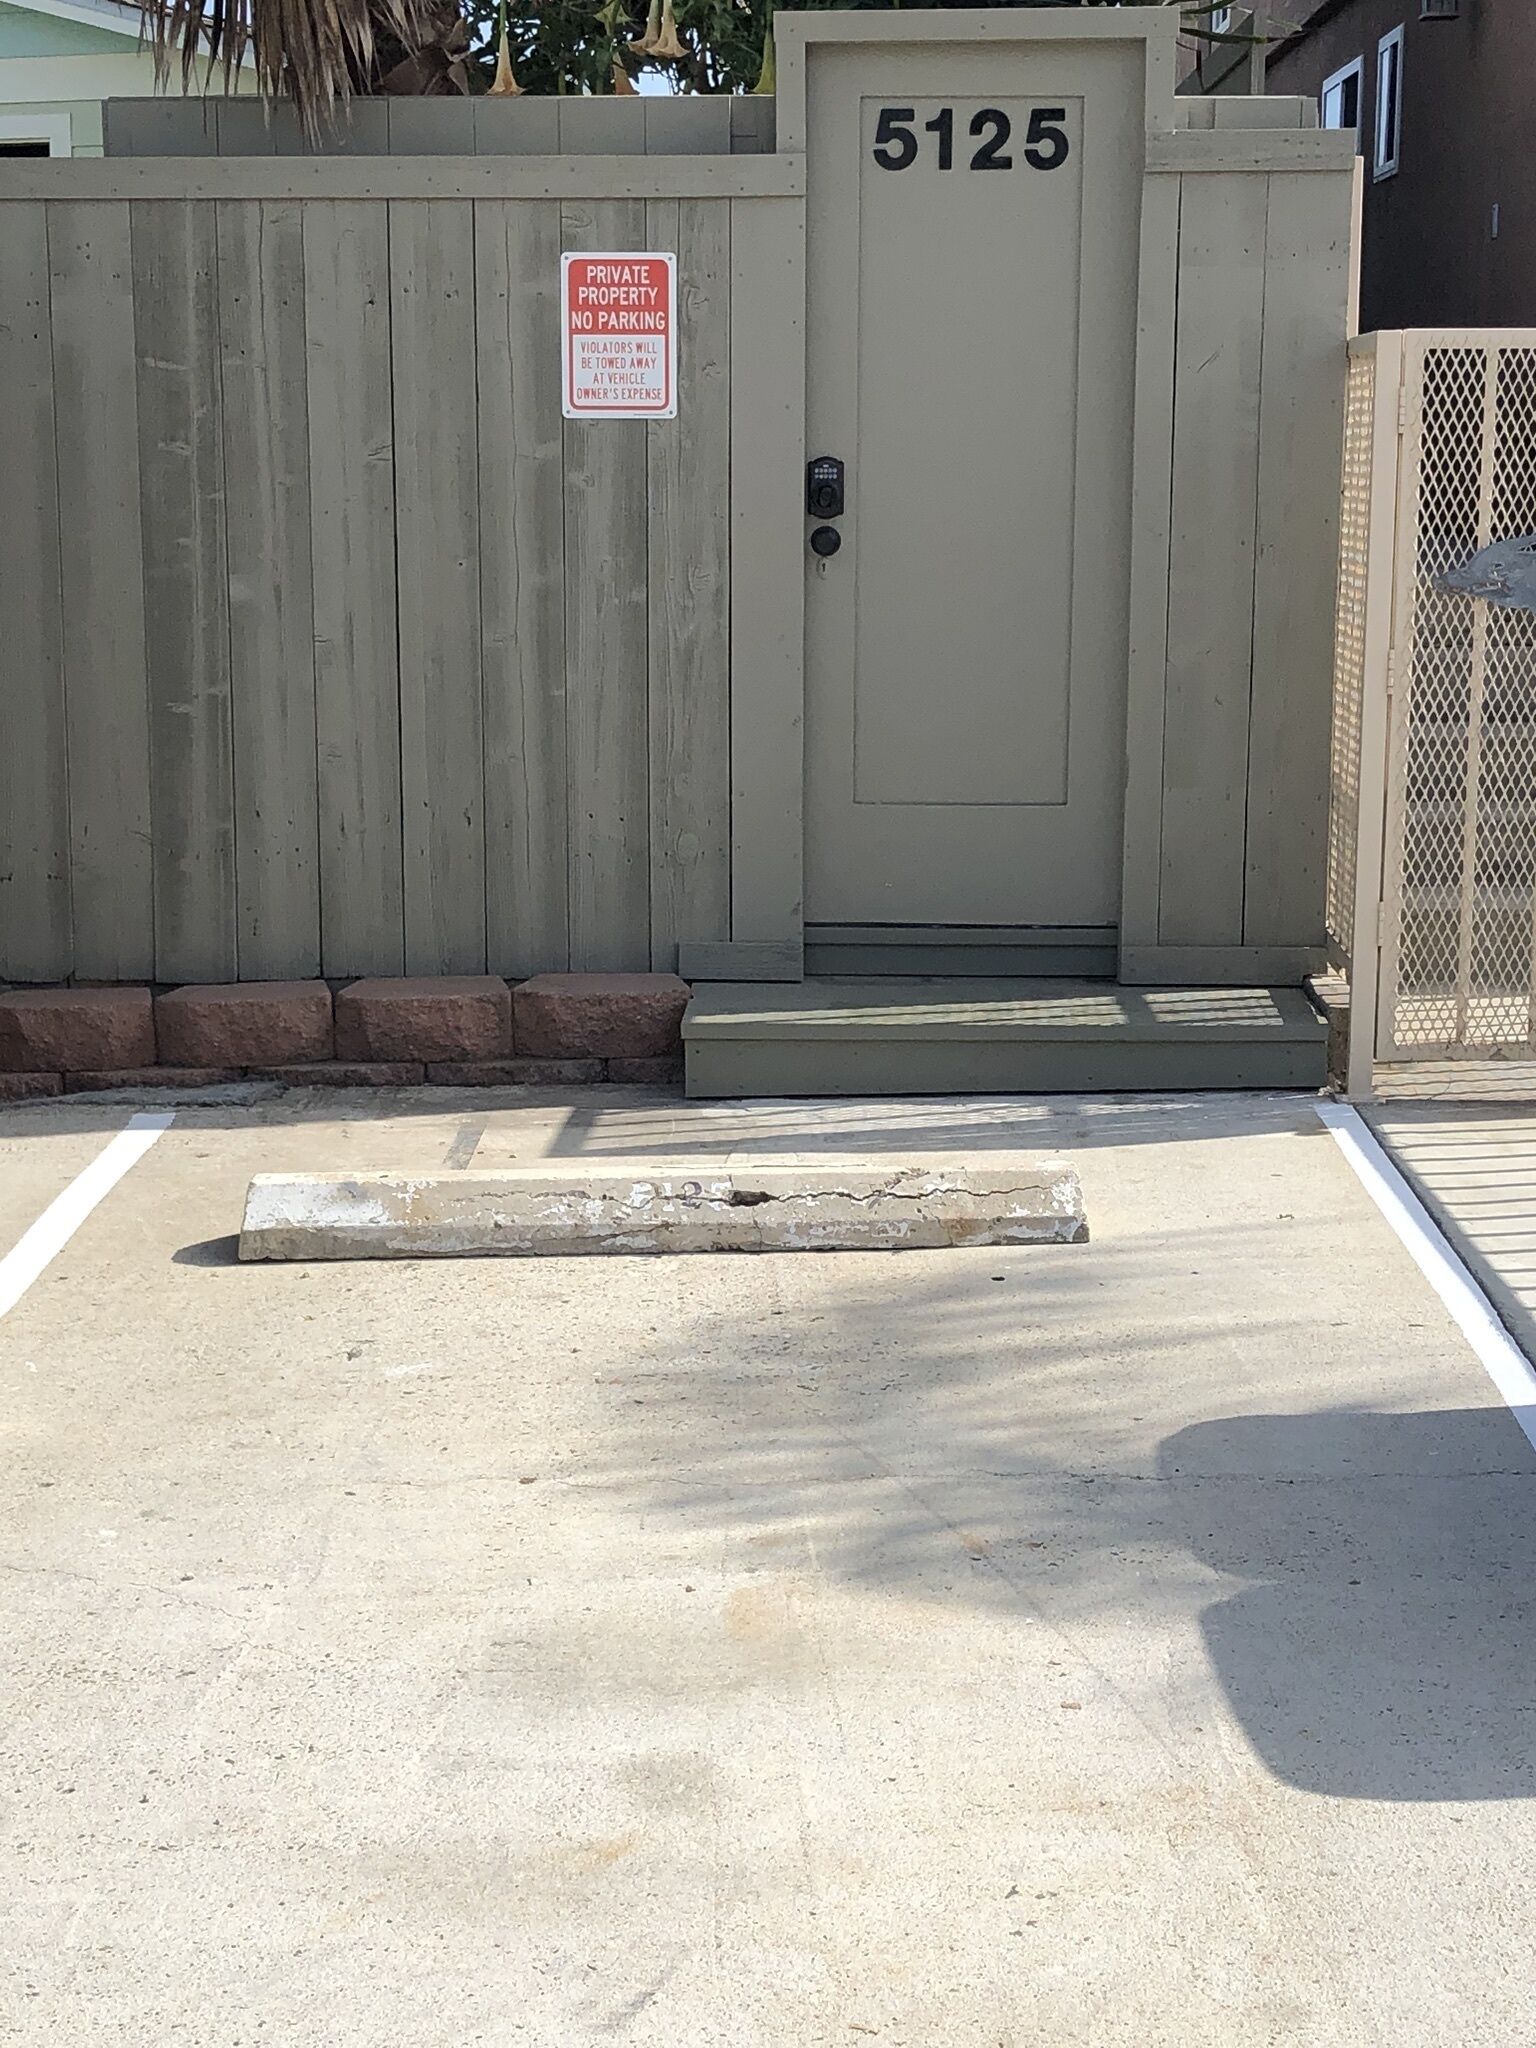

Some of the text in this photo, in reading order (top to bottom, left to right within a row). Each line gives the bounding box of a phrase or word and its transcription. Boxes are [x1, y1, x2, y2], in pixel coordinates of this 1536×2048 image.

[873, 108, 1069, 171] 5125
[587, 265, 650, 284] PRIVATE
[578, 286, 658, 306] PROPERTY
[571, 311, 666, 330] NO PARKING
[580, 341, 658, 354] VIOLATORS WILL
[581, 357, 657, 369] BE TOWED AWAY
[593, 372, 646, 385] AT VEHICLE
[576, 387, 662, 400] OWNER'S EXPENSE
